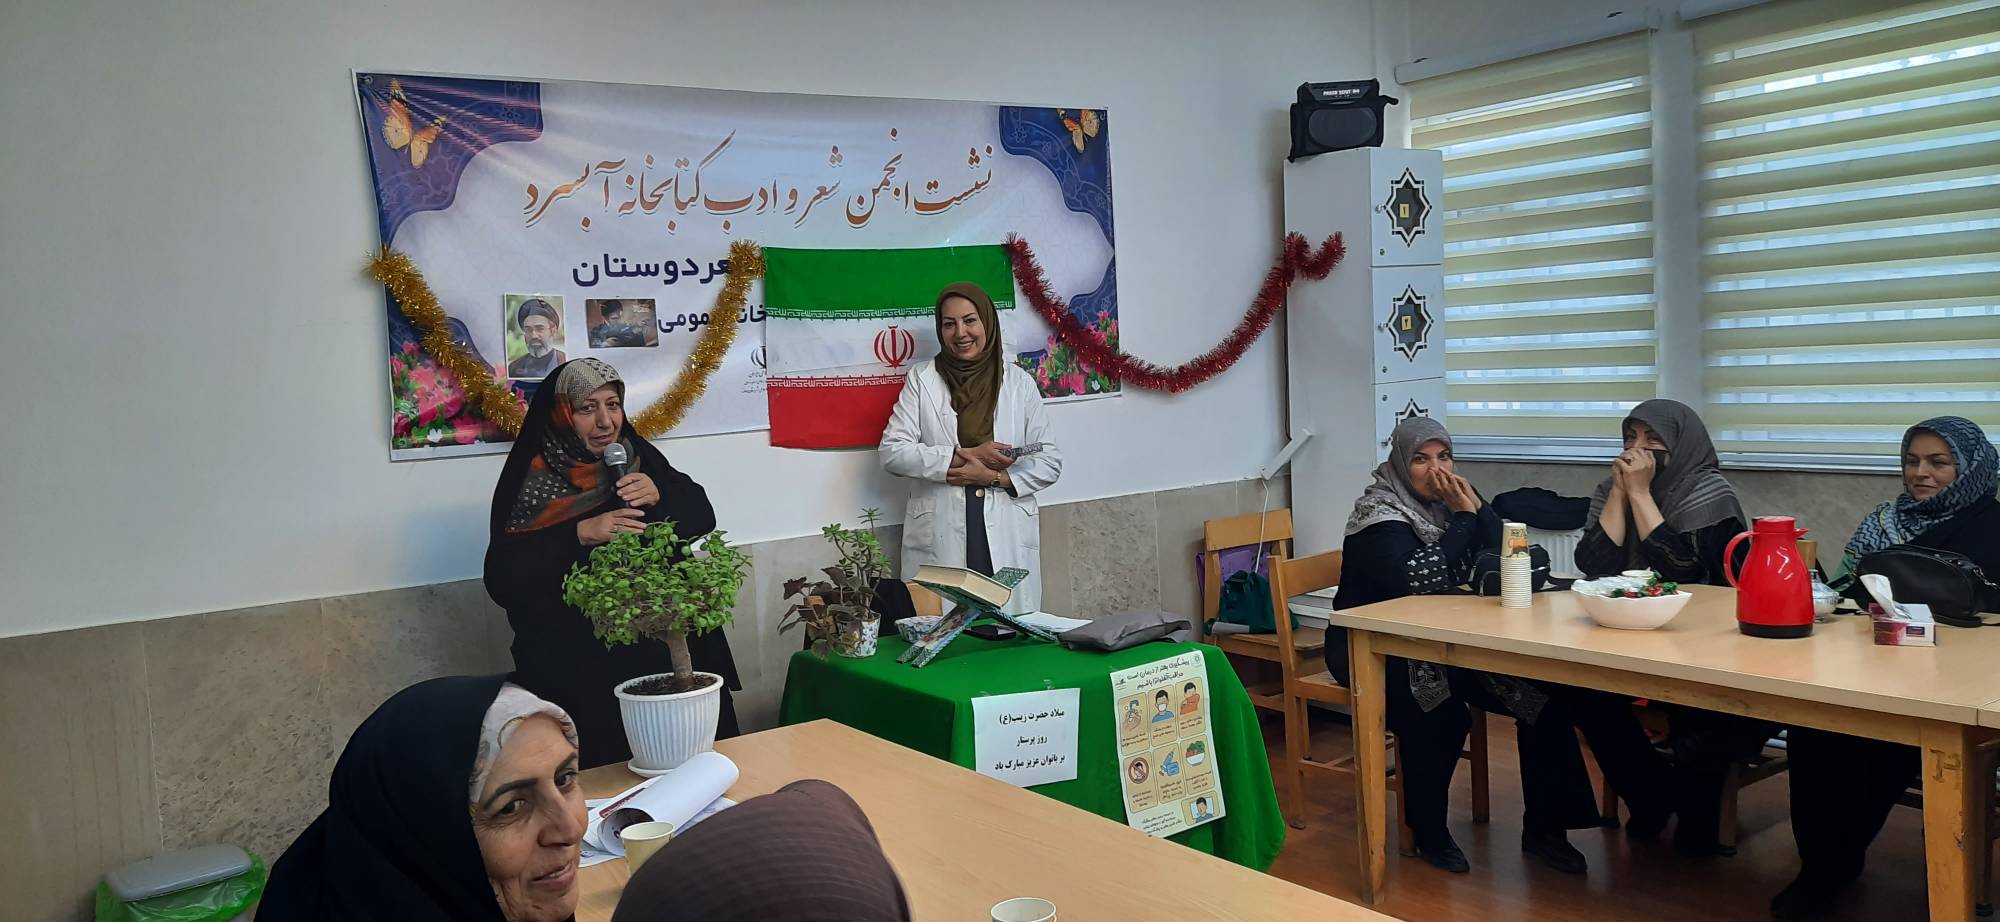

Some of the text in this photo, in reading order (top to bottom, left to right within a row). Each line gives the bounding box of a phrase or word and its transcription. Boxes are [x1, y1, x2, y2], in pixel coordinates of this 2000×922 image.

[523, 127, 993, 232] نشست انجمن شعر و ادب کتابخانه آبسرد
[657, 311, 710, 333] مومی
[1028, 711, 1049, 722] حضرت
[1050, 707, 1065, 718] میلاد
[1016, 735, 1048, 747] روز پرستار
[994, 753, 1066, 771] بر بانوان عزیز مبارک باد
